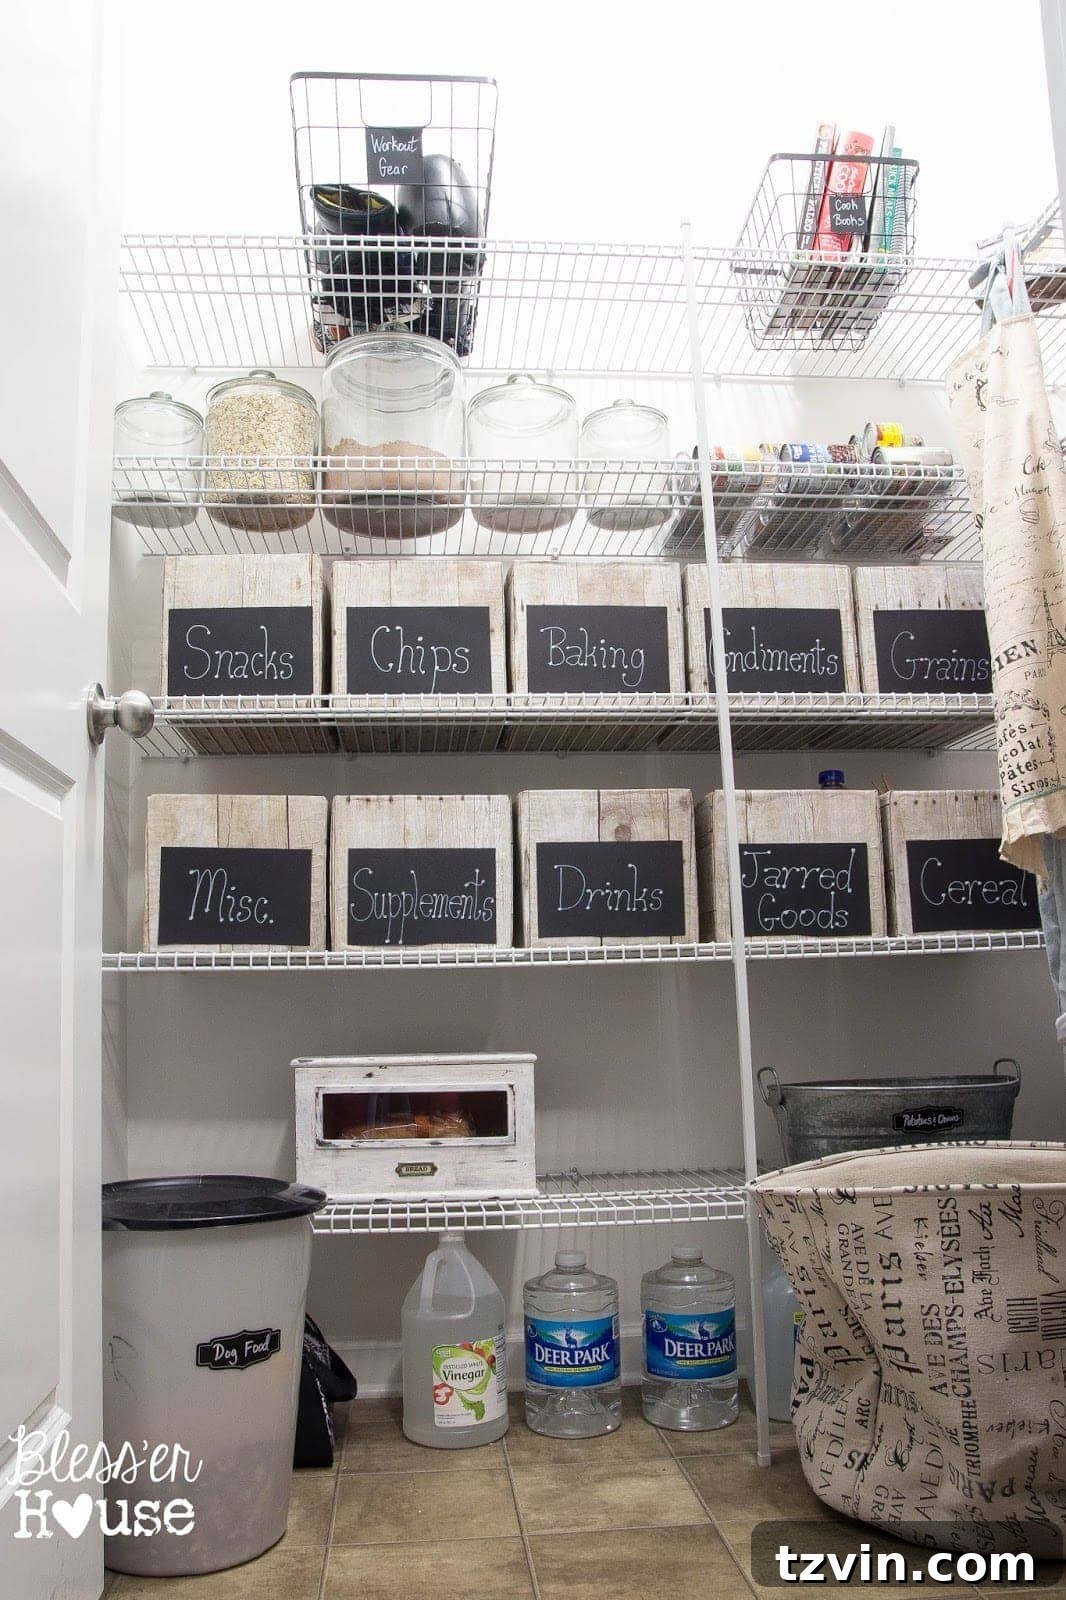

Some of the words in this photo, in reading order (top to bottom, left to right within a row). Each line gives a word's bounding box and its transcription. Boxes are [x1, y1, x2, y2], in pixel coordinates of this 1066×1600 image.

[371, 134, 418, 153] Workout
[379, 157, 408, 177] Gear
[184, 624, 295, 681] Snacks
[371, 625, 470, 694] Chips
[540, 626, 645, 687] Baking
[891, 630, 989, 681] Grains
[553, 864, 664, 913] Drinks
[742, 847, 857, 893] Jarred
[920, 857, 1028, 907] Cereal
[189, 868, 274, 925] Misc.
[350, 868, 494, 945] Supplements
[757, 891, 849, 931] Goods
[664, 1337, 706, 1358] DEER
[706, 1331, 735, 1356] PARK
[921, 1303, 944, 1346] DES
[212, 1343, 238, 1365] Dog
[244, 1333, 270, 1357] Food
[535, 1343, 574, 1366] DEER
[574, 1341, 610, 1366] PARK
[442, 1369, 485, 1382] Vinegar
